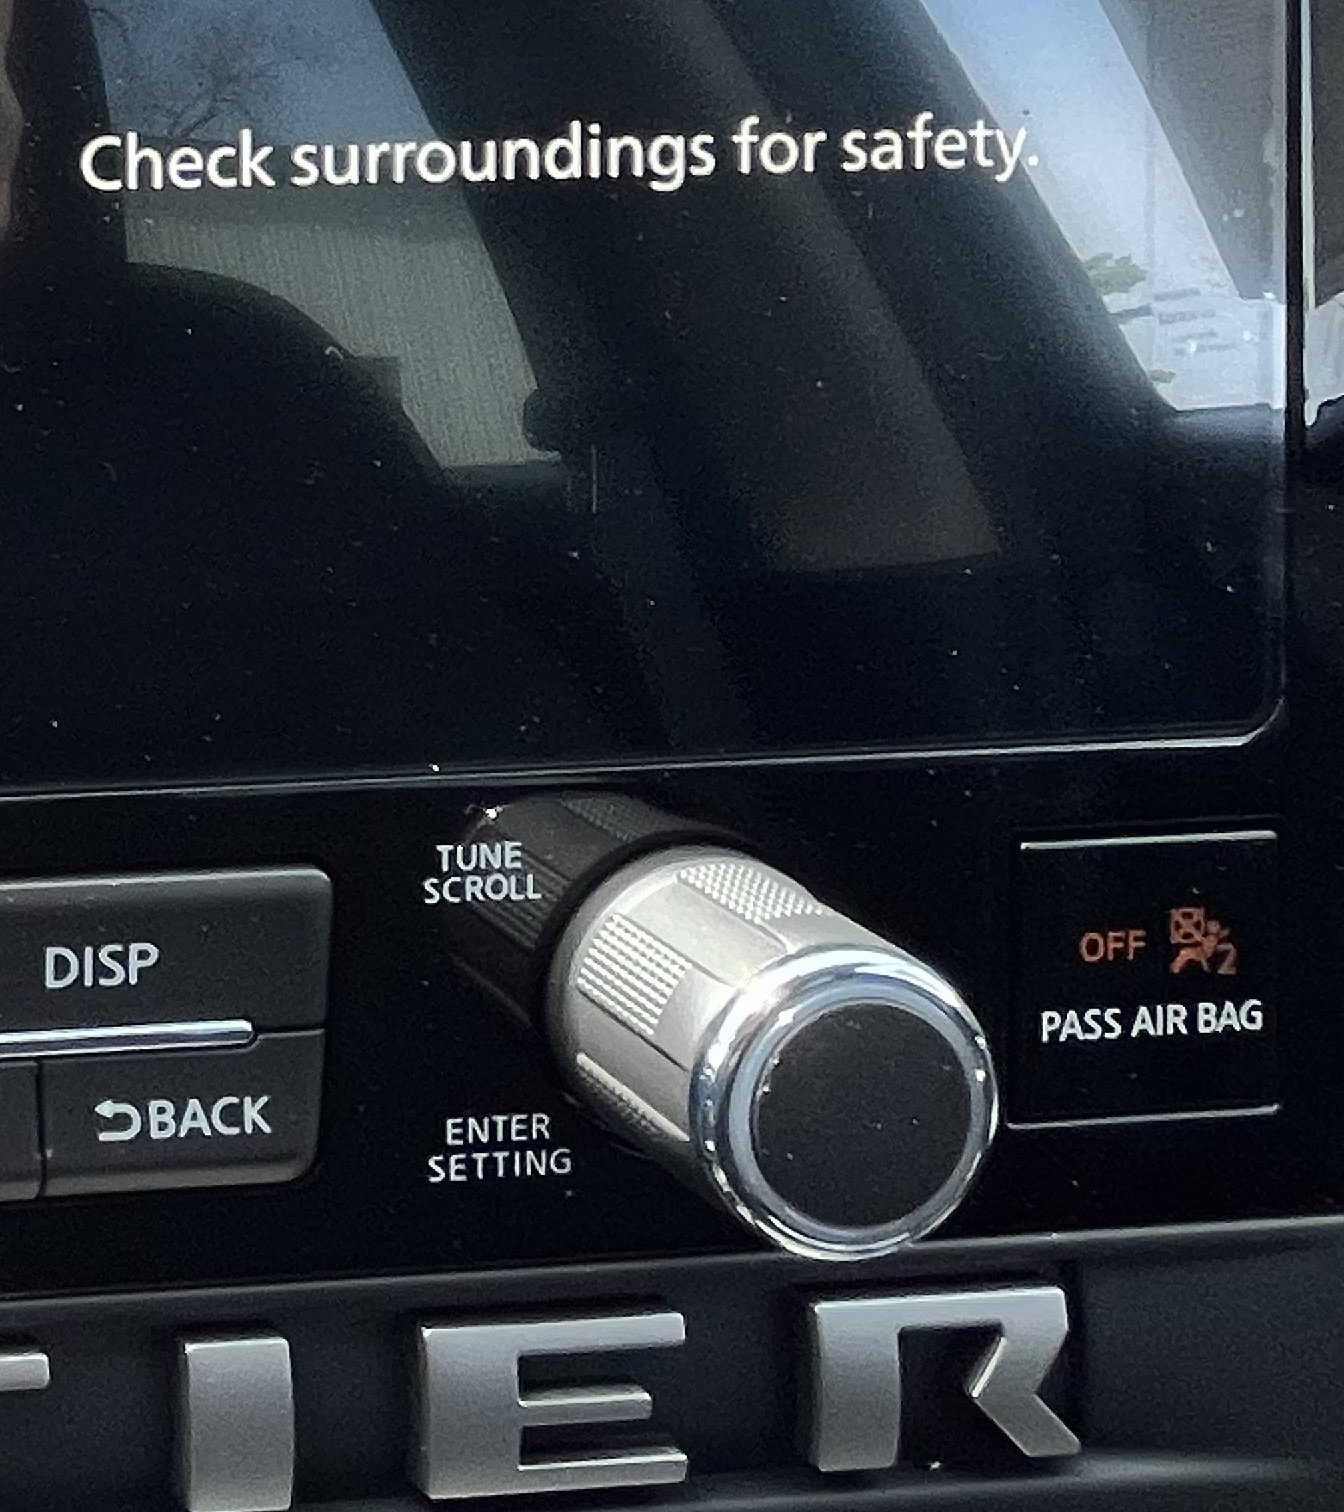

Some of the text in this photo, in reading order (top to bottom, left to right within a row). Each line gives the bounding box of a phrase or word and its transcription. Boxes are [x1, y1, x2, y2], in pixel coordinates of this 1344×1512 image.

[80, 113, 1040, 193] Check surroundings for safety.
[435, 840, 524, 873] TUNE
[422, 872, 542, 905] SCROLL
[1079, 929, 1147, 963] OFF
[43, 942, 161, 991] DISP
[1039, 998, 1264, 1045] PASS AIR BAG
[146, 1094, 273, 1141] BACK
[445, 1112, 551, 1148] ENTER
[427, 1146, 573, 1184] SETTING
